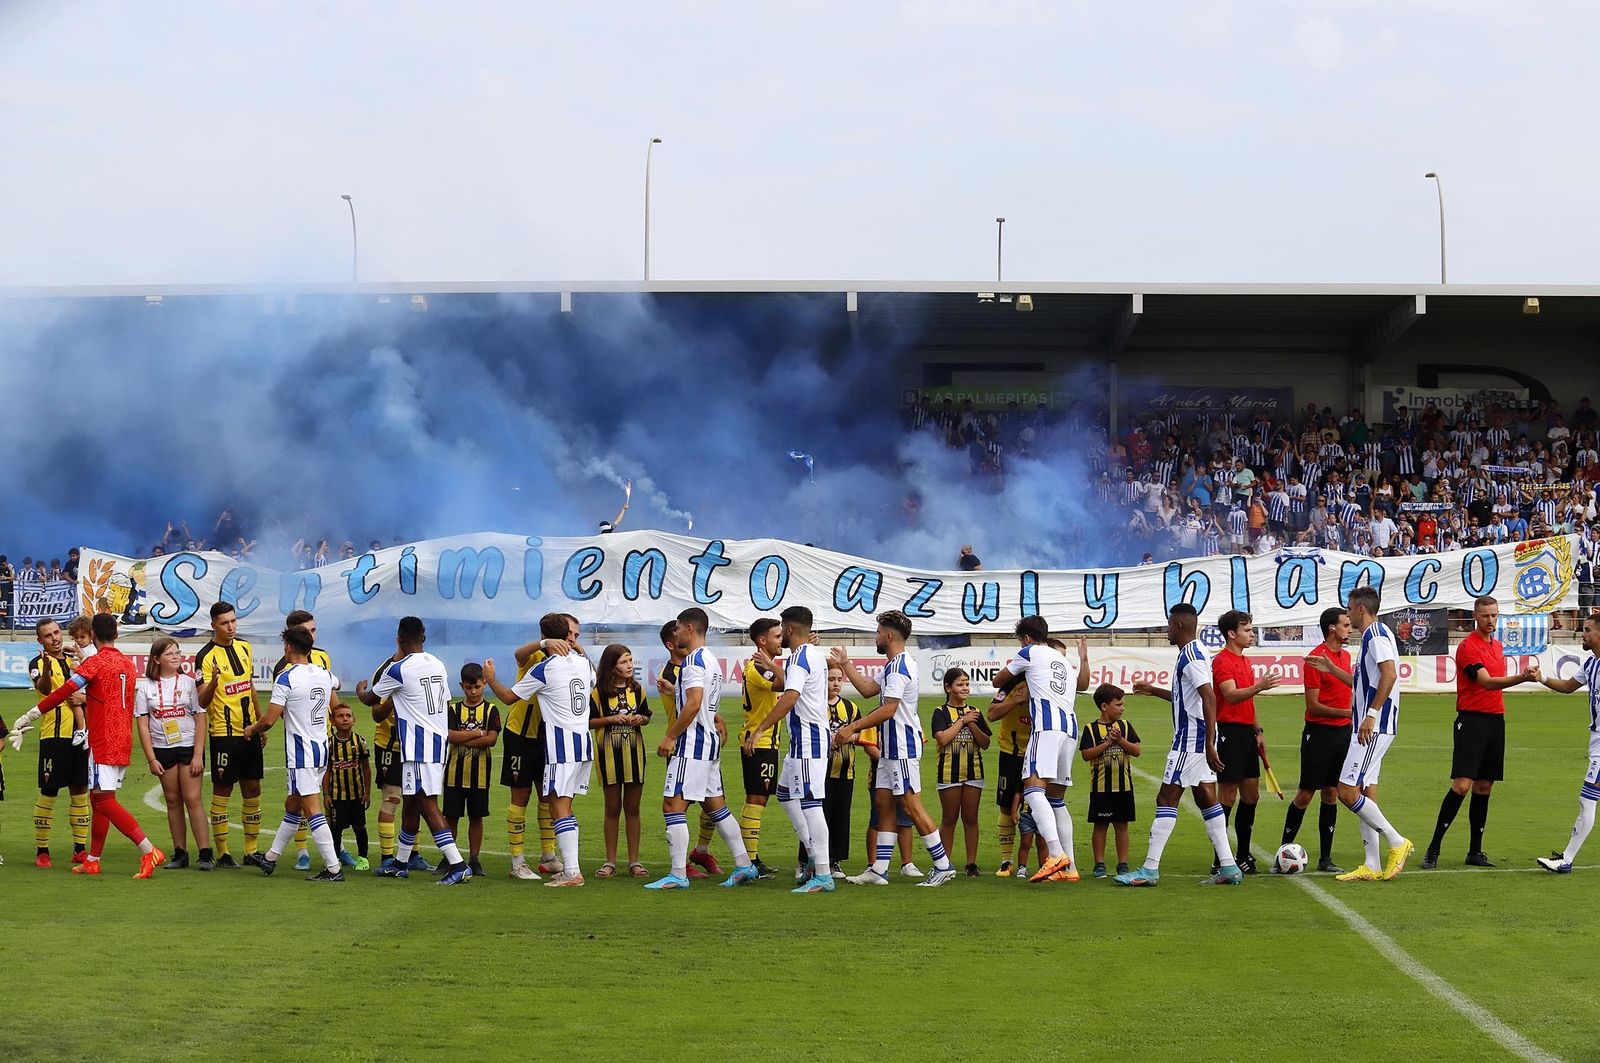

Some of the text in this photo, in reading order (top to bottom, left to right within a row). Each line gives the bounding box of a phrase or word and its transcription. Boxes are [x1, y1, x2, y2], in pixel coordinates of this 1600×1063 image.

[956, 391, 1048, 404] PALMERITAS
[150, 535, 1500, 630] Sentimiento azul y blanco
[977, 659, 1001, 668] jamón
[1050, 661, 1067, 695] 3
[1120, 666, 1169, 685] Lepe
[119, 673, 127, 709] 1
[419, 675, 445, 716] 17
[570, 678, 587, 716] 6
[310, 687, 326, 726] 2
[43, 758, 54, 773] 14
[217, 752, 229, 767] 16
[380, 751, 393, 766] 18
[510, 756, 521, 771] 21
[760, 763, 775, 779] 20
